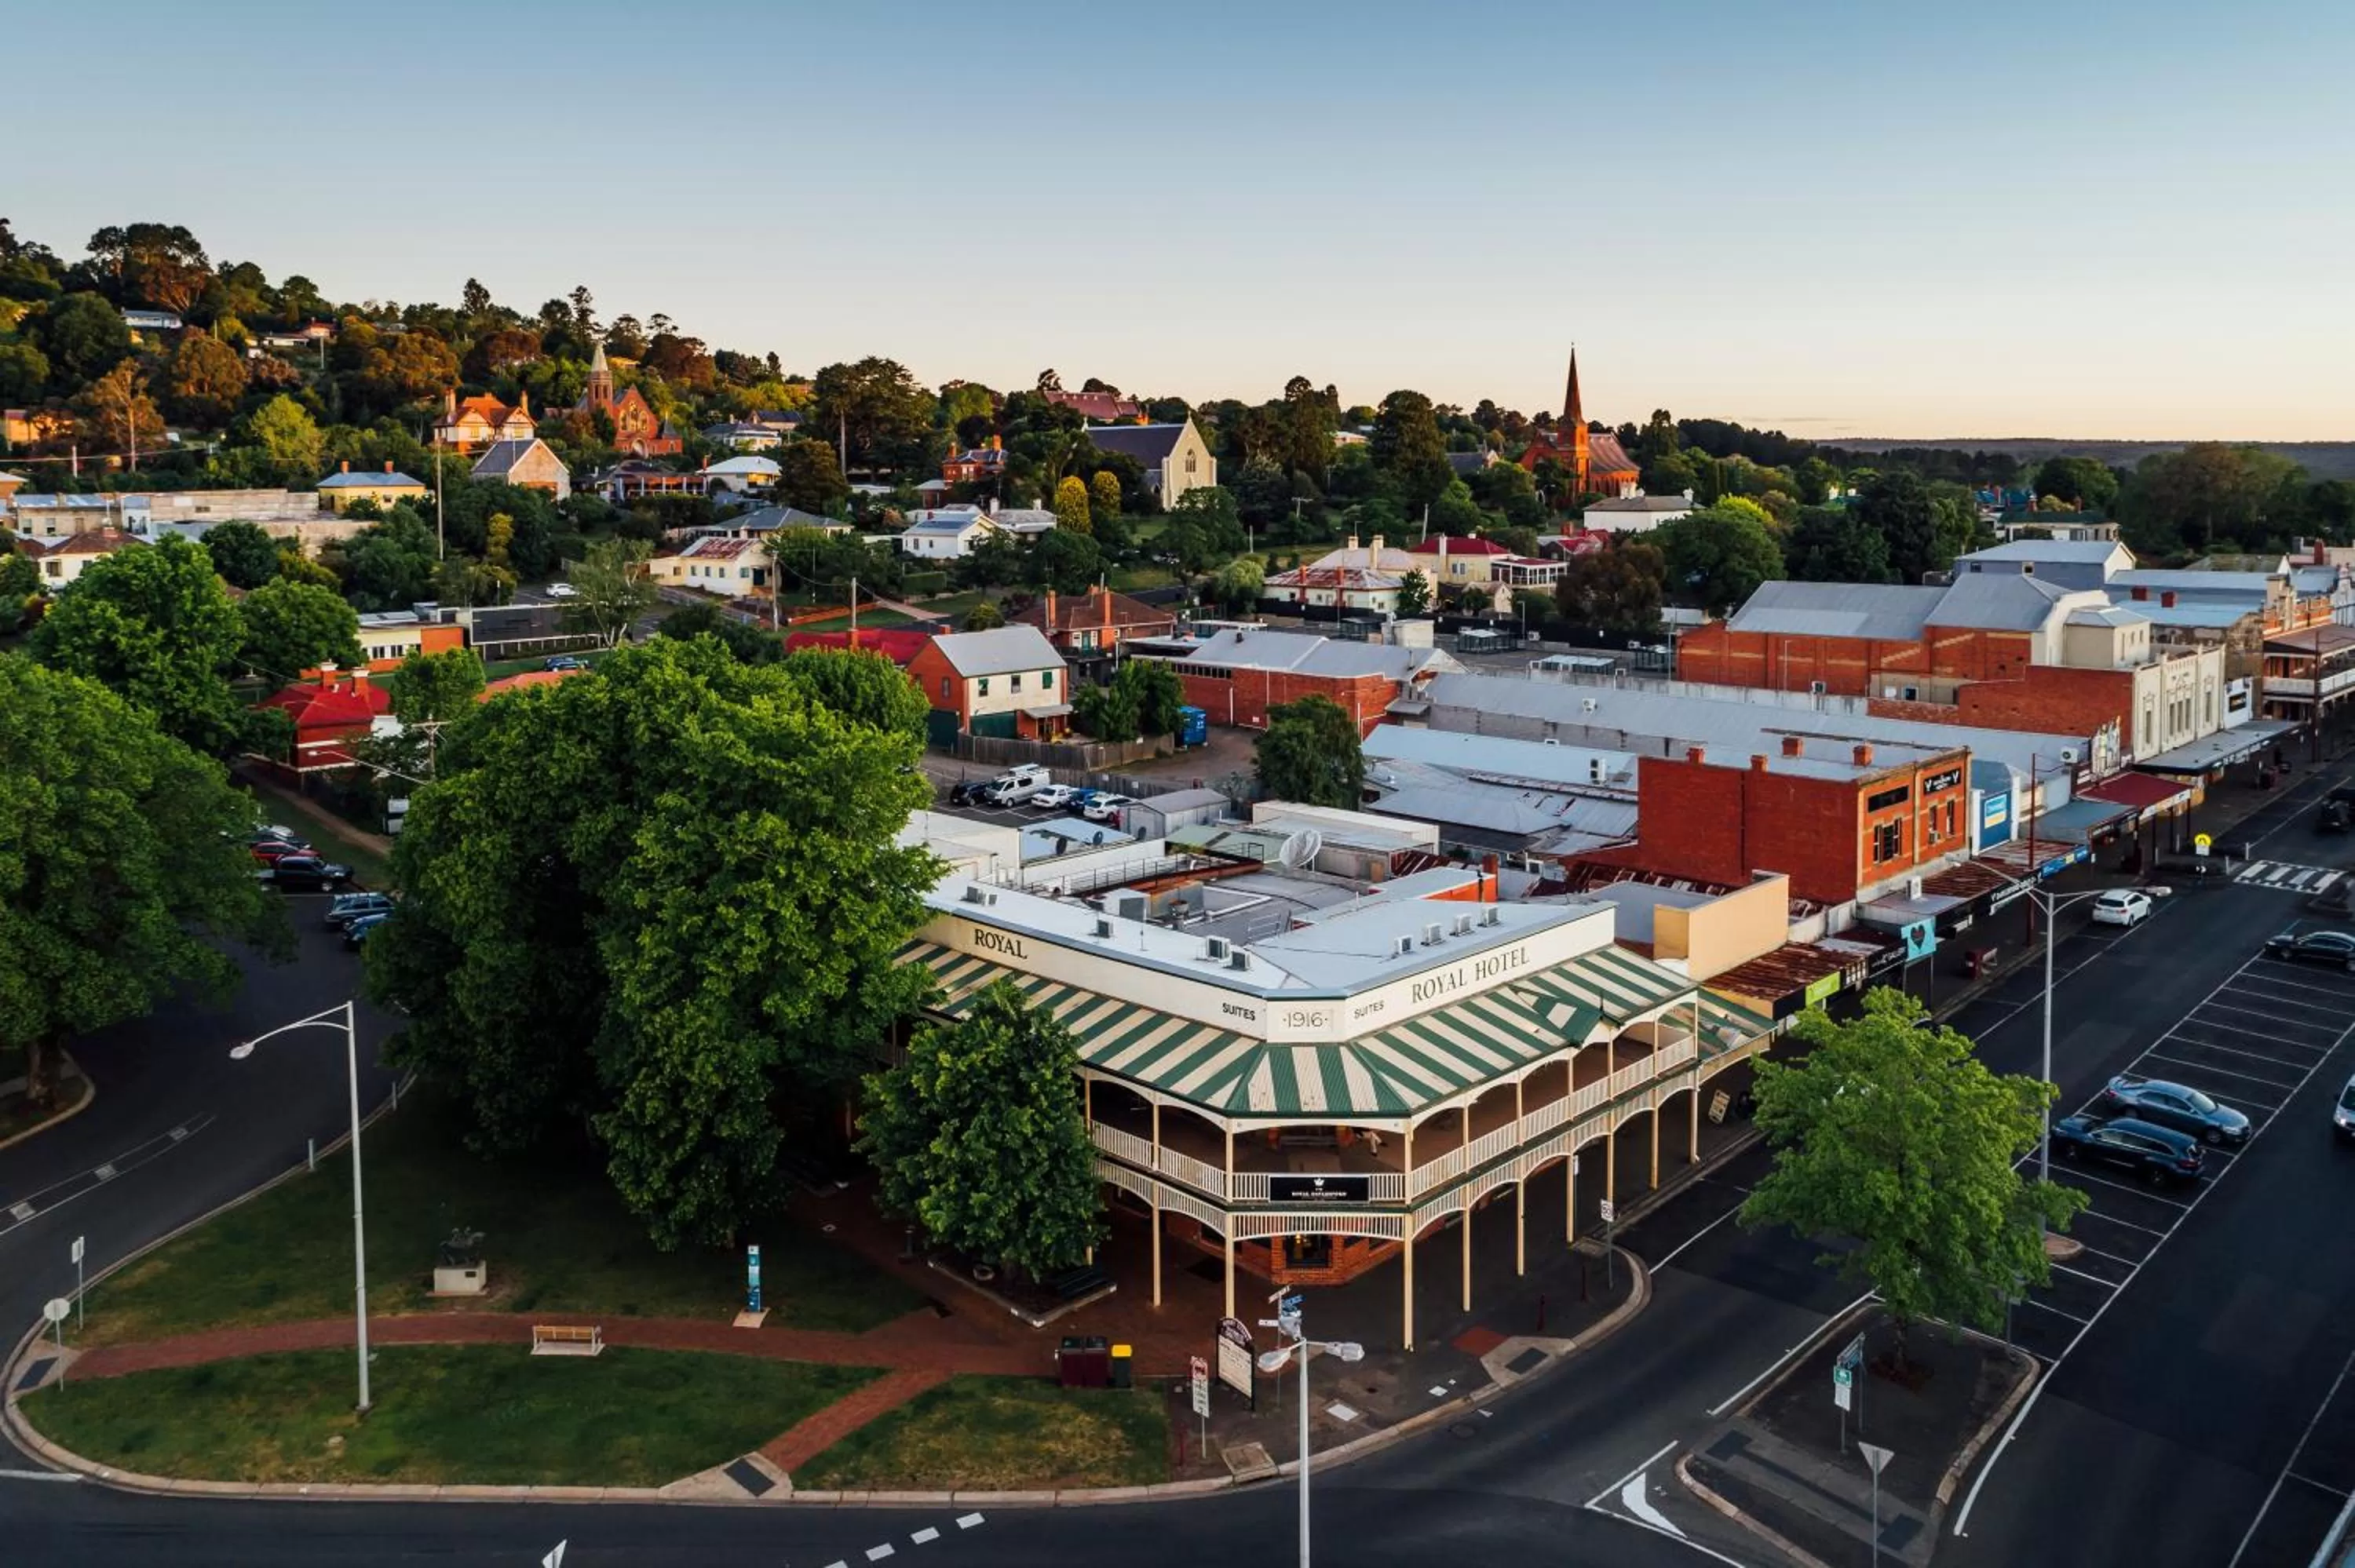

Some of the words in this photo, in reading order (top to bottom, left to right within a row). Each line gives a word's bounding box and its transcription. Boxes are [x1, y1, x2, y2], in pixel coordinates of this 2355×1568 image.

[974, 928, 1028, 959] ROYAL
[1412, 968, 1466, 1004] ROYAL
[1475, 946, 1530, 980] HOTEL
[1222, 1002, 1256, 1020] SUITES
[1354, 1000, 1384, 1019] SUITES
